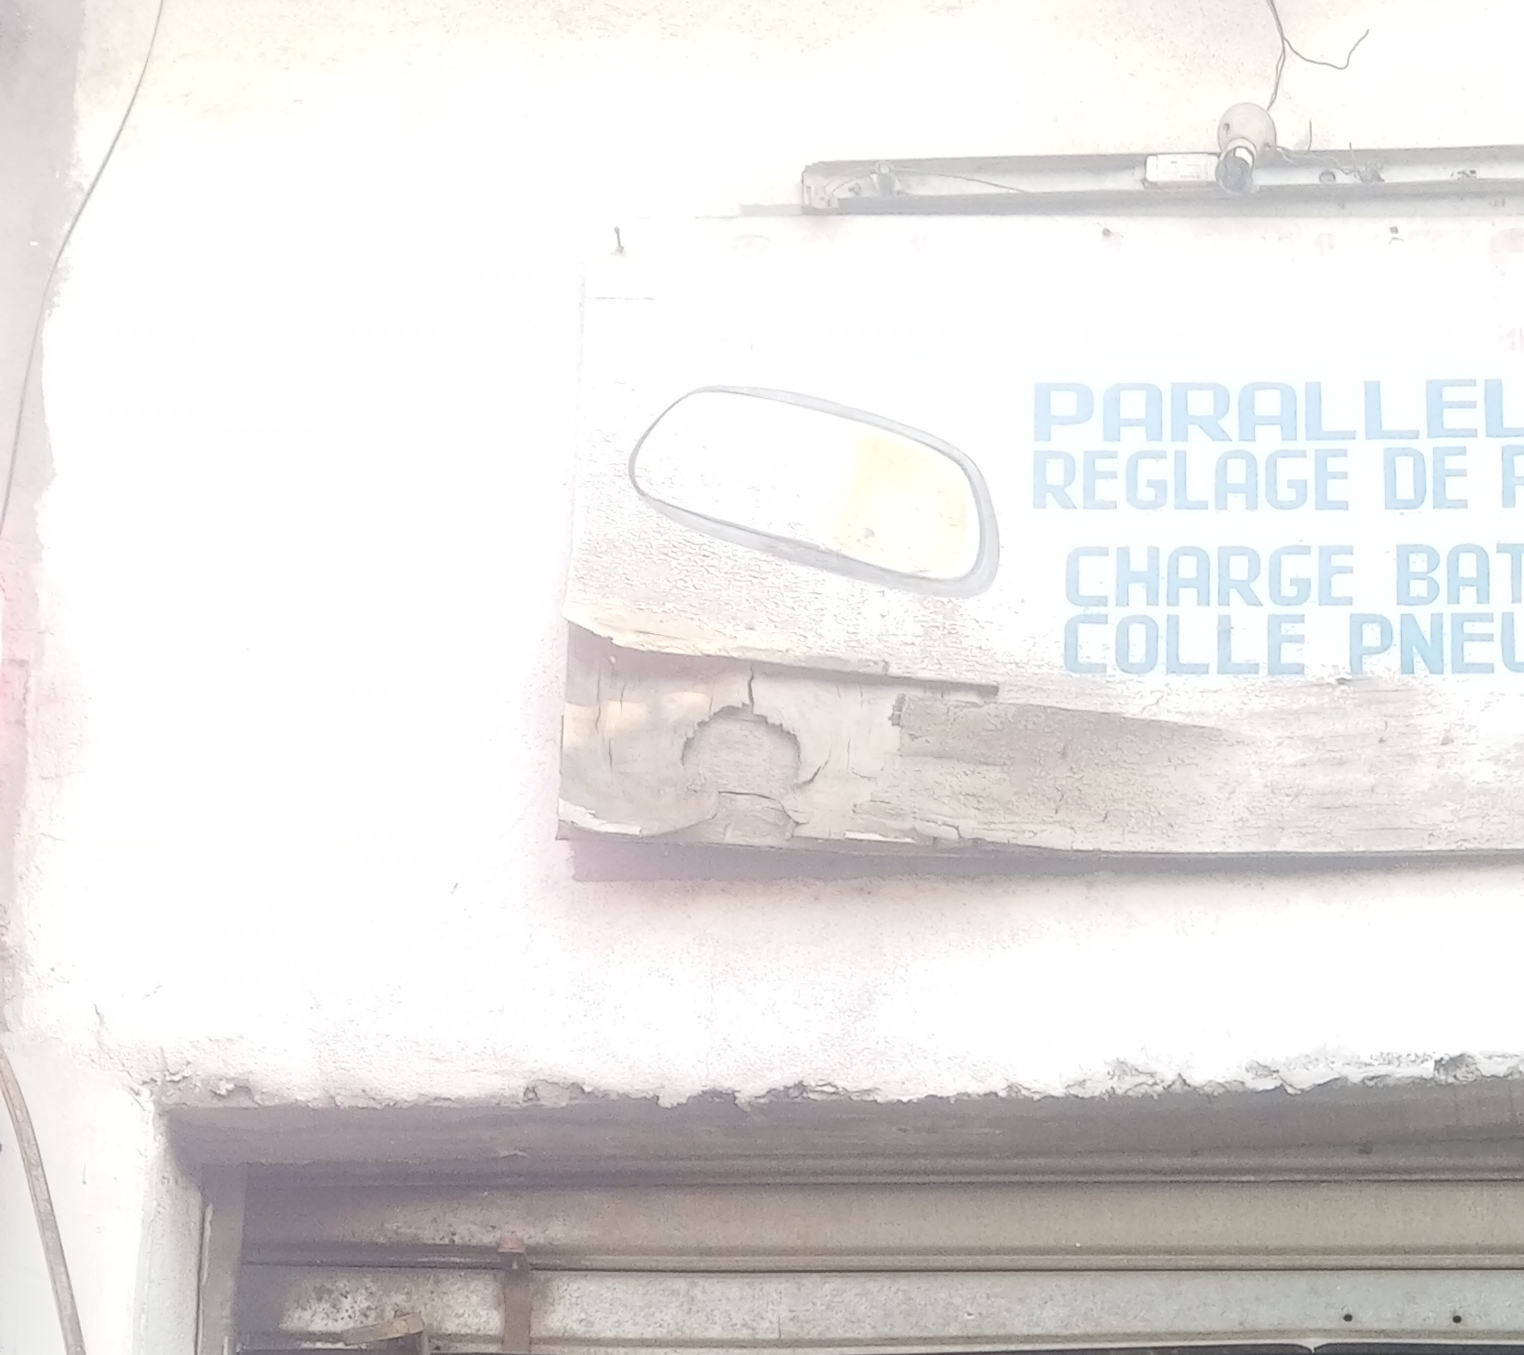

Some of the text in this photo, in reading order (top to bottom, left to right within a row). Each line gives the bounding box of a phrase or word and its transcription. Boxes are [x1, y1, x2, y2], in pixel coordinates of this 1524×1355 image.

[1031, 447, 1350, 511] REGLAGE
[1383, 445, 1469, 511] DE
[1064, 544, 1355, 608] CHARGE
[1062, 612, 1308, 677] COLLE
